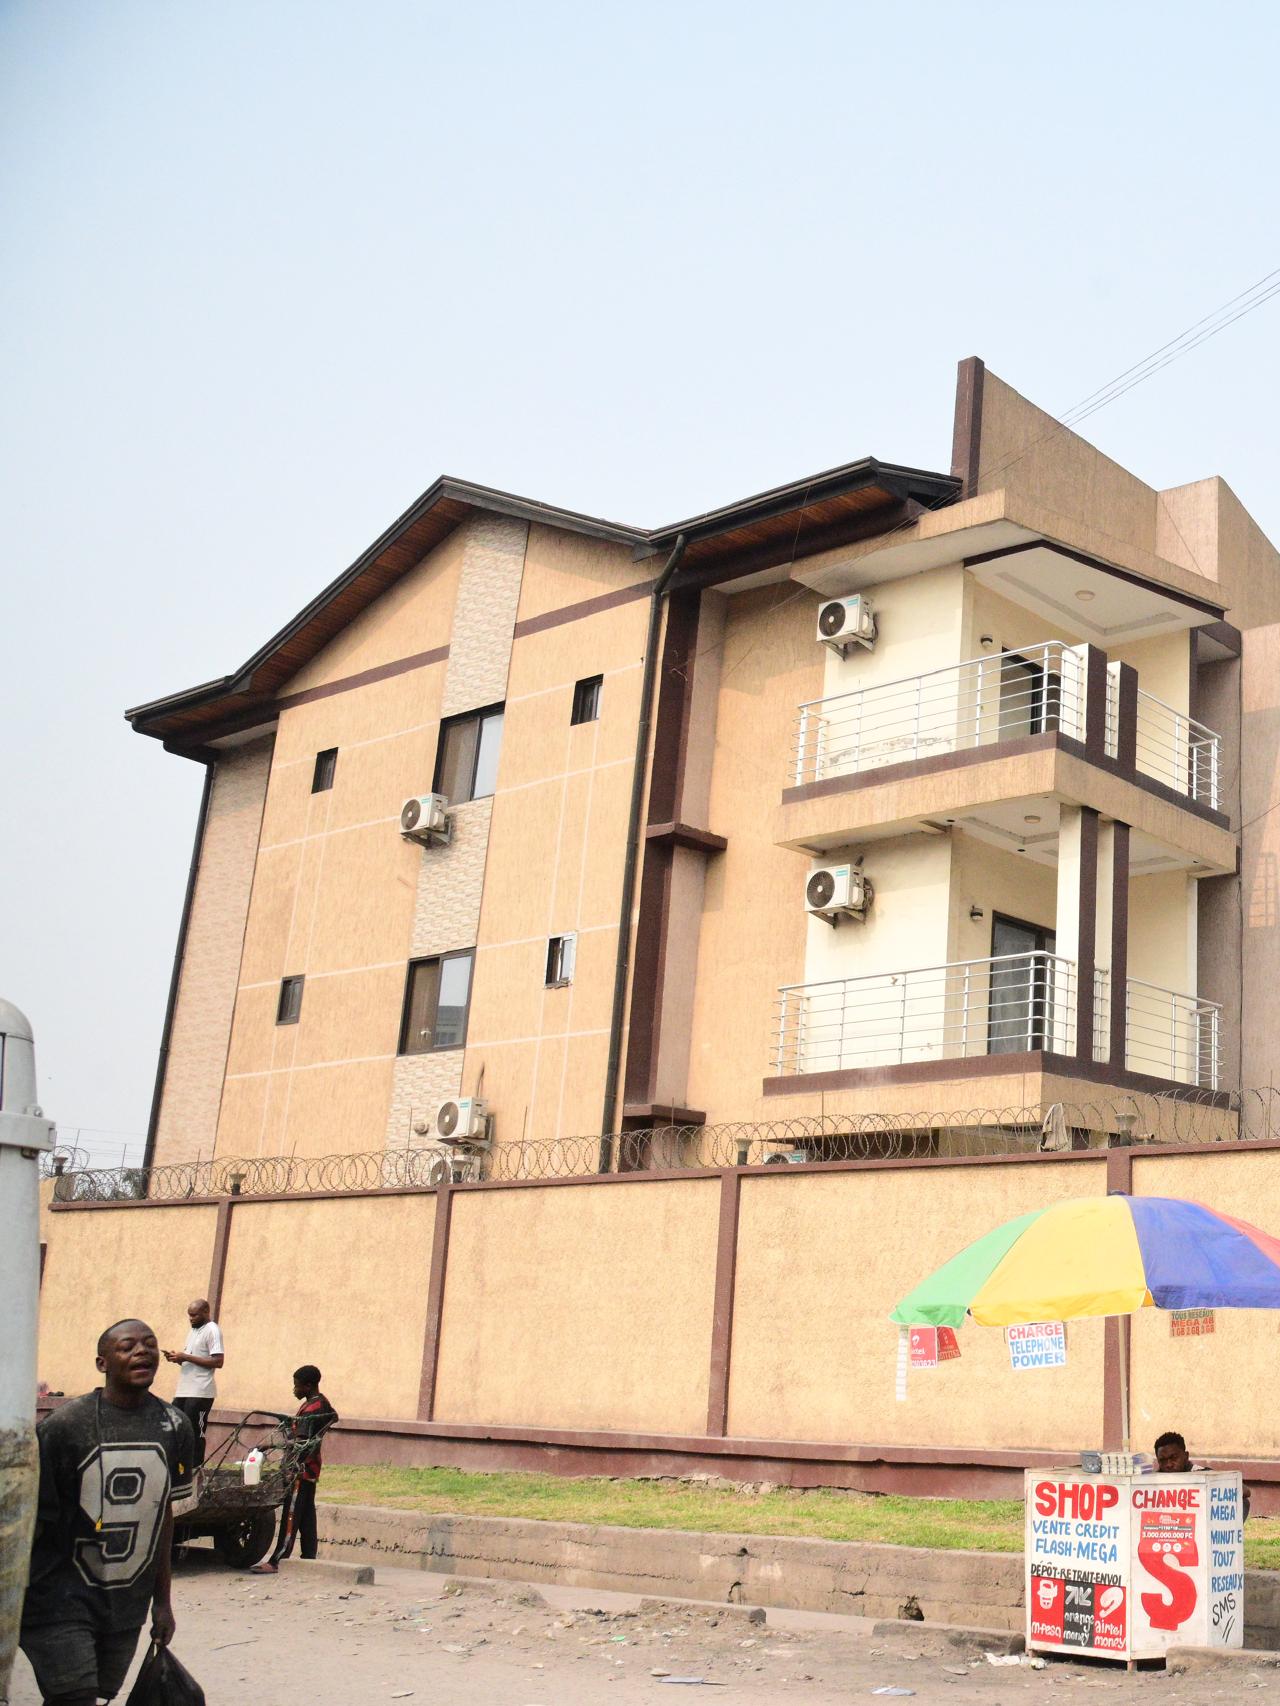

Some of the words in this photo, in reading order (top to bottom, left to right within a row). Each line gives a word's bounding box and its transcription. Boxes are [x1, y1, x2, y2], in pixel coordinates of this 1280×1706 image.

[1009, 1324, 1062, 1340] CHARGE
[1010, 1336, 1064, 1355] TELEPHONE
[1012, 1352, 1065, 1368] POWER
[1035, 1481, 1119, 1521] SHOP
[1132, 1488, 1200, 1510] CHANGE
[1210, 1487, 1238, 1502] FLASH
[73, 1442, 171, 1590] 9
[1210, 1505, 1236, 1521] MEGA
[1032, 1519, 1071, 1536] VENTE
[1075, 1523, 1119, 1539] CREDIT
[1212, 1551, 1236, 1568] TOUT
[1211, 1574, 1243, 1593] RESEAUX
[1212, 1593, 1236, 1626] SMS
[1064, 1612, 1094, 1633] orange
[1094, 1619, 1123, 1636] airtel
[1094, 1635, 1127, 1649] money
